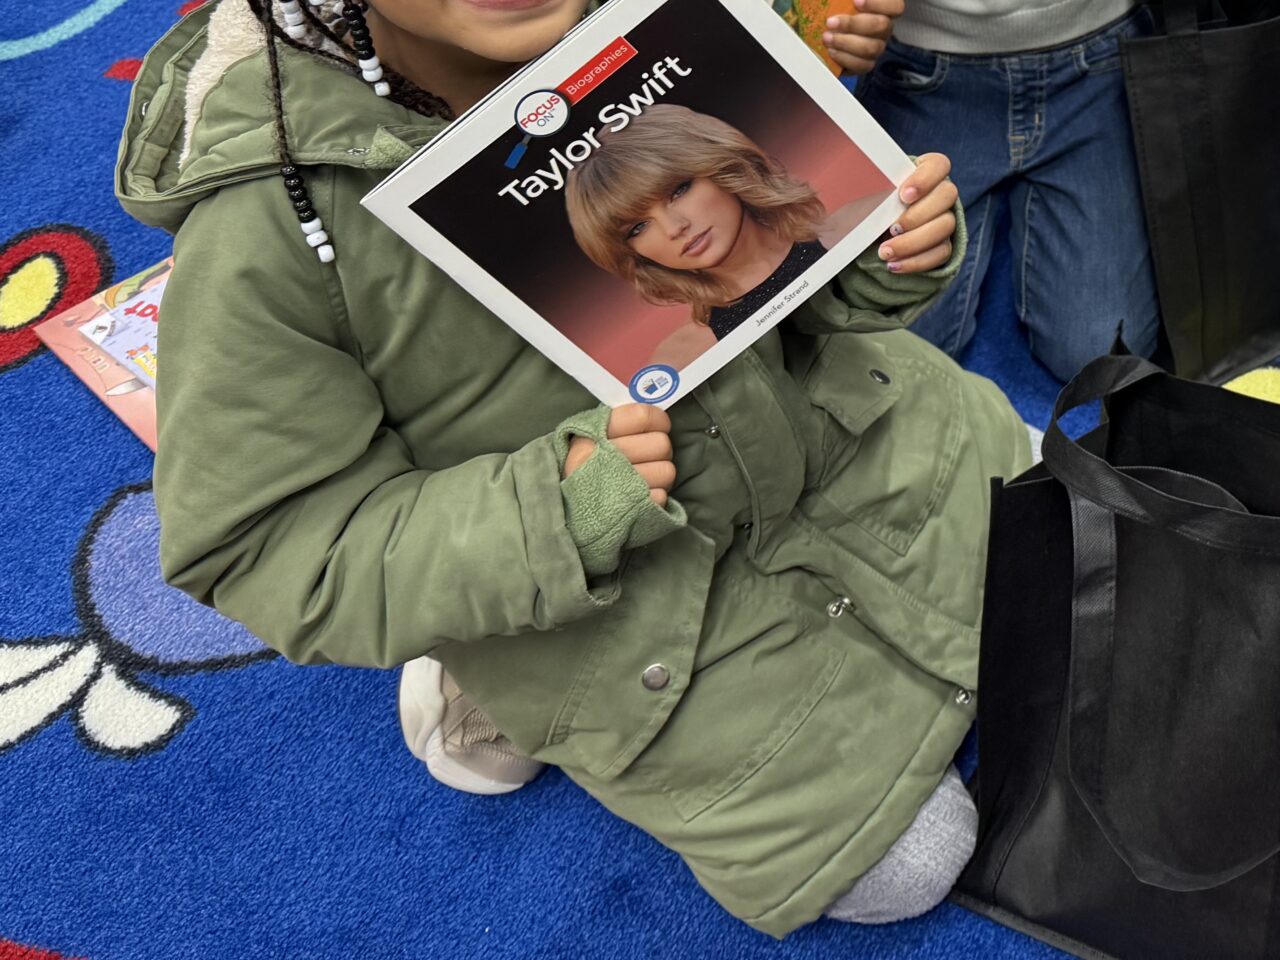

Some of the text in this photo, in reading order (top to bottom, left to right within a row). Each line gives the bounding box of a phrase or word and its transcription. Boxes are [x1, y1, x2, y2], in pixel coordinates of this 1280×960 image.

[565, 44, 628, 96] Biographies
[498, 56, 692, 206] Taylor Swift
[520, 95, 560, 129] FOCUS
[755, 280, 809, 327] Jennifer Strand
